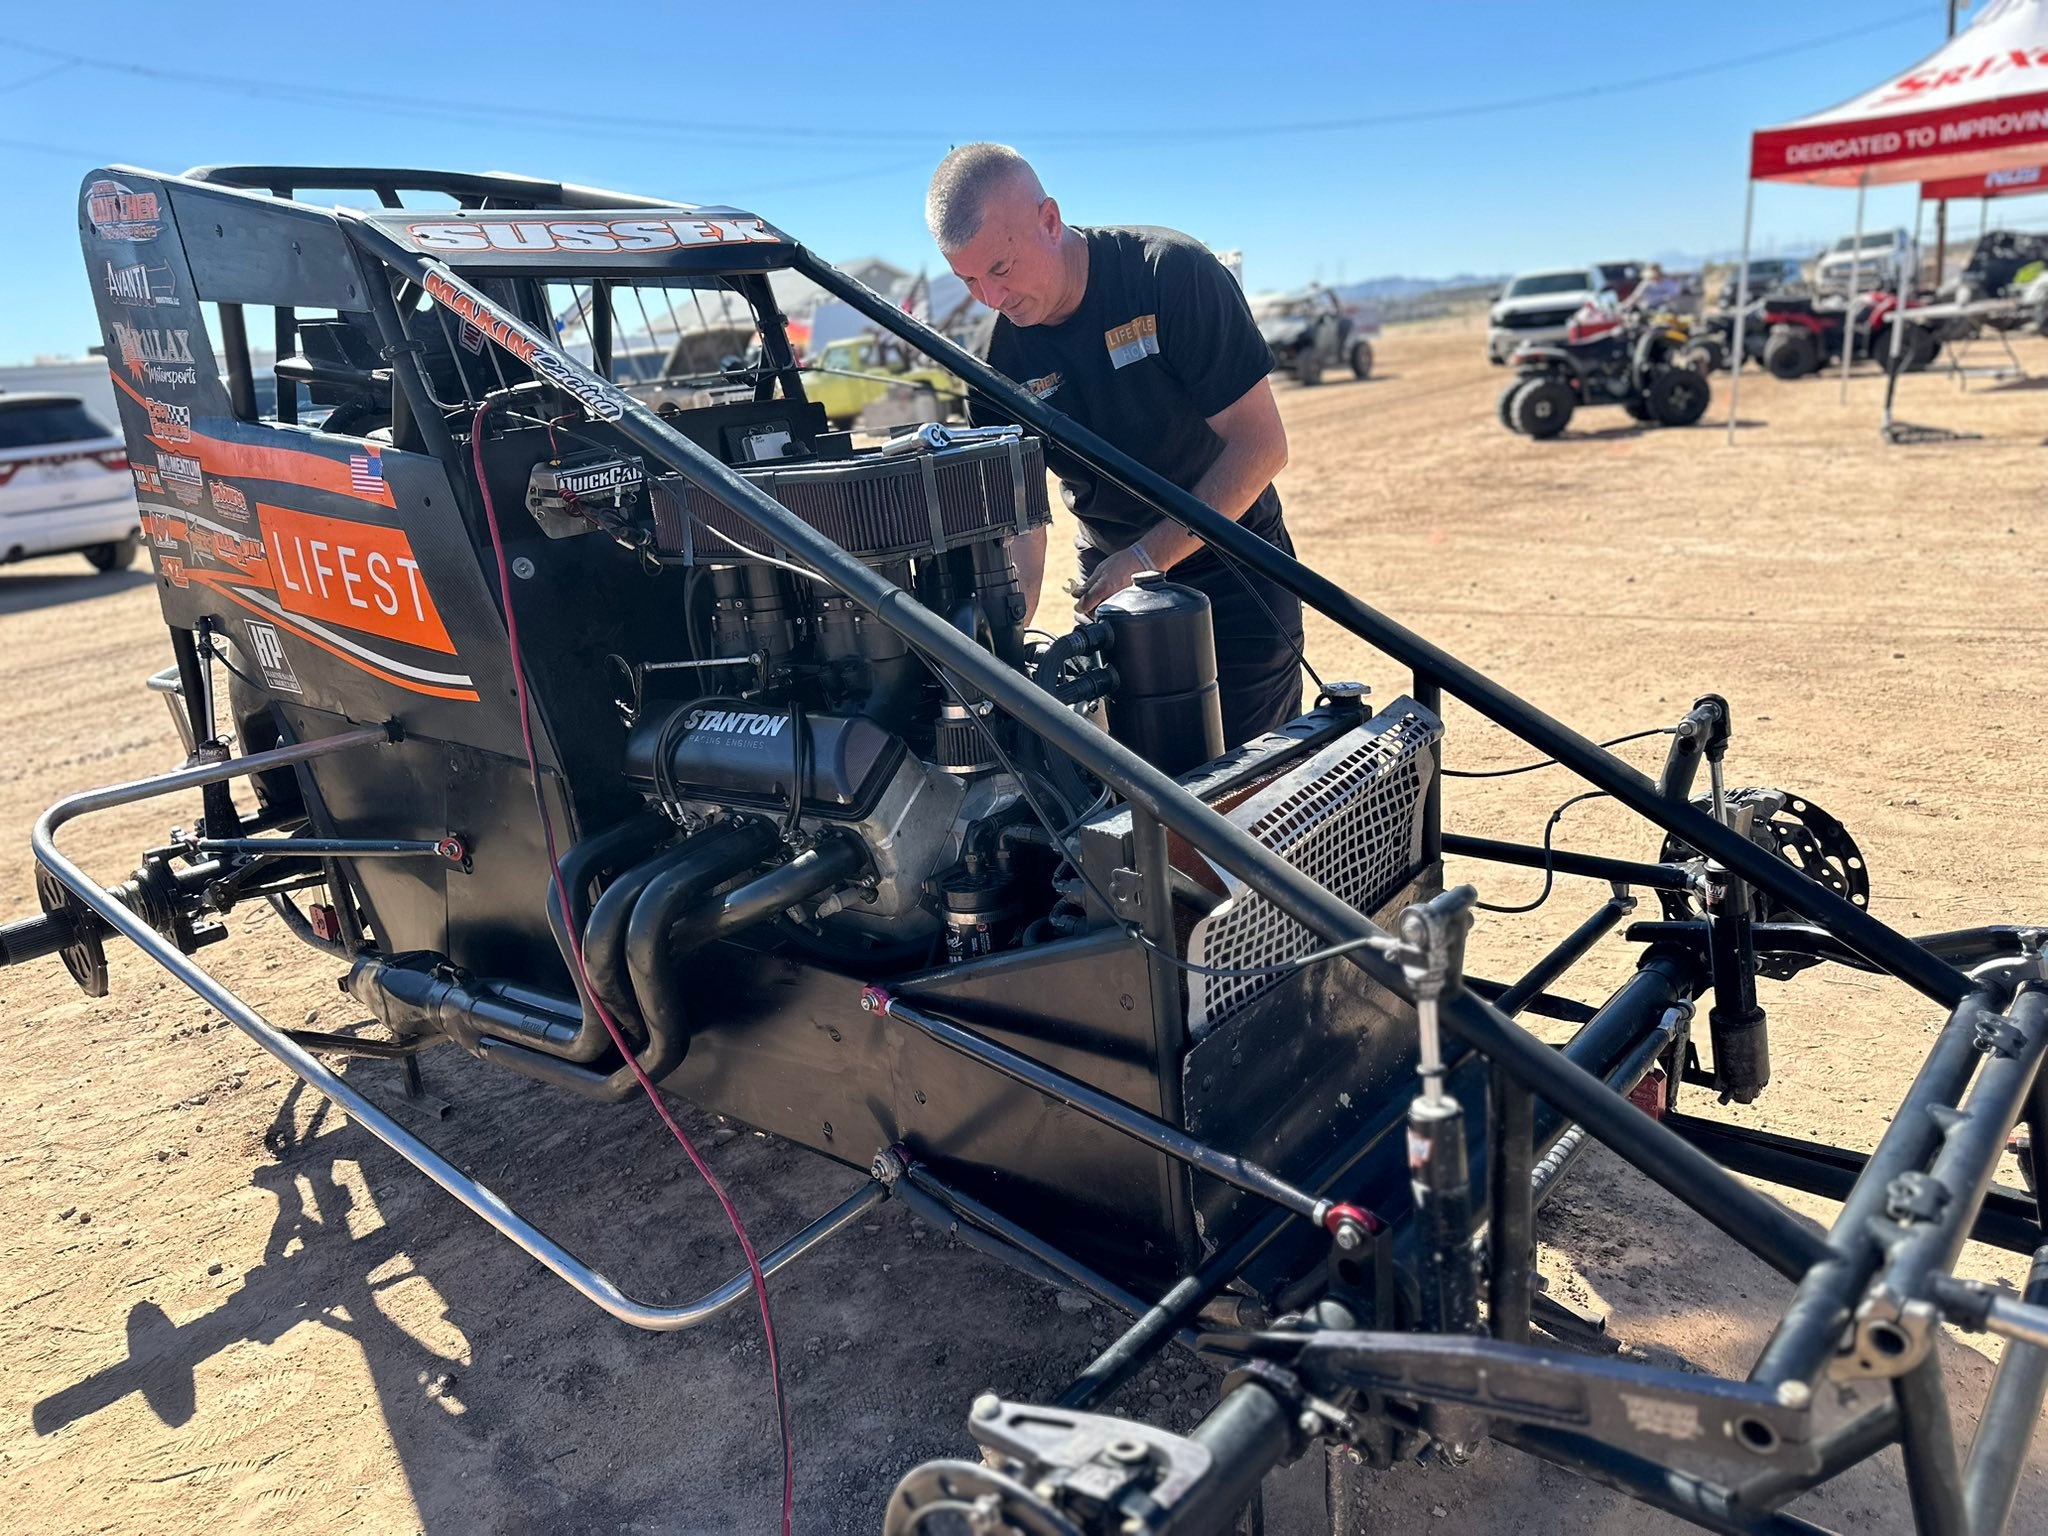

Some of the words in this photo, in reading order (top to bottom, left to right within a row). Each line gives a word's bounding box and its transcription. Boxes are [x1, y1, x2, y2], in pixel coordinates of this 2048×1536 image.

[1786, 132, 1901, 165] DEDICATED
[1904, 126, 1936, 149] TO
[1939, 107, 2048, 144] IMPROVIN
[407, 219, 780, 254] SUSSEX
[106, 261, 151, 300] AVANTI
[156, 453, 201, 480] MOMENTUM
[272, 531, 424, 622] LIFEST
[250, 625, 282, 669] HP
[684, 709, 789, 737] STANTON
[689, 734, 721, 745] RACING
[726, 738, 765, 750] ENGINES
